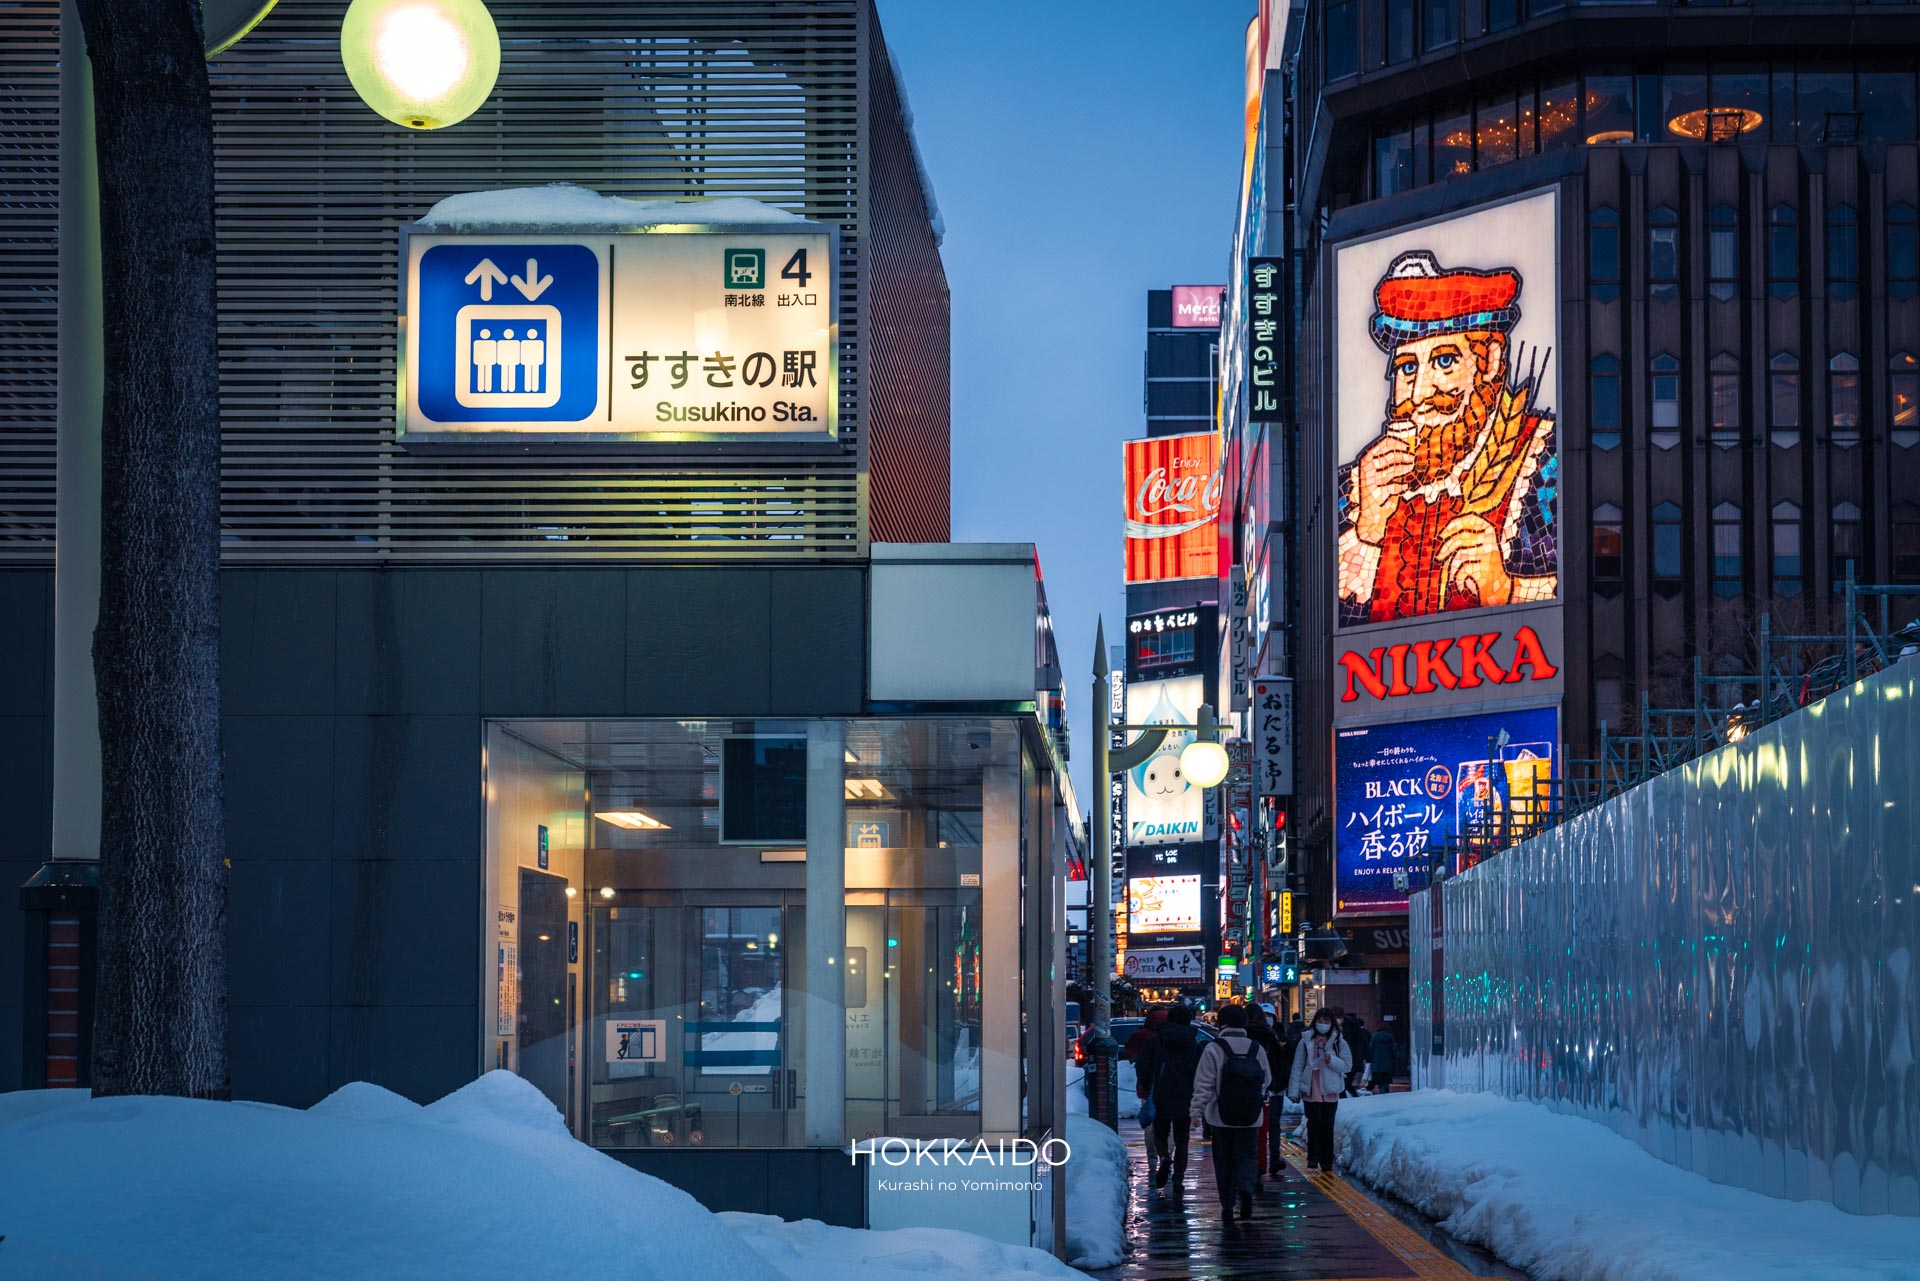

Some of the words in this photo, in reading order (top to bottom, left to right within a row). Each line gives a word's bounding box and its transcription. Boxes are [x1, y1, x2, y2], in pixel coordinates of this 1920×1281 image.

[780, 248, 812, 287] 4
[724, 293, 766, 308] 南北線
[777, 293, 817, 307] 出入口
[1253, 265, 1278, 412] すすきのビル
[624, 350, 817, 389] すすきの駅
[655, 401, 767, 422] Susukino
[772, 401, 818, 422] Sta.
[1173, 457, 1201, 469] Enjoy
[1338, 625, 1559, 702] NIKKA
[1365, 778, 1423, 799] BLACK
[1345, 803, 1444, 829] ハイボール
[1145, 821, 1199, 837] DAIKIN
[1359, 826, 1430, 861] 香る夜
[1354, 868, 1375, 876] ENJOY
